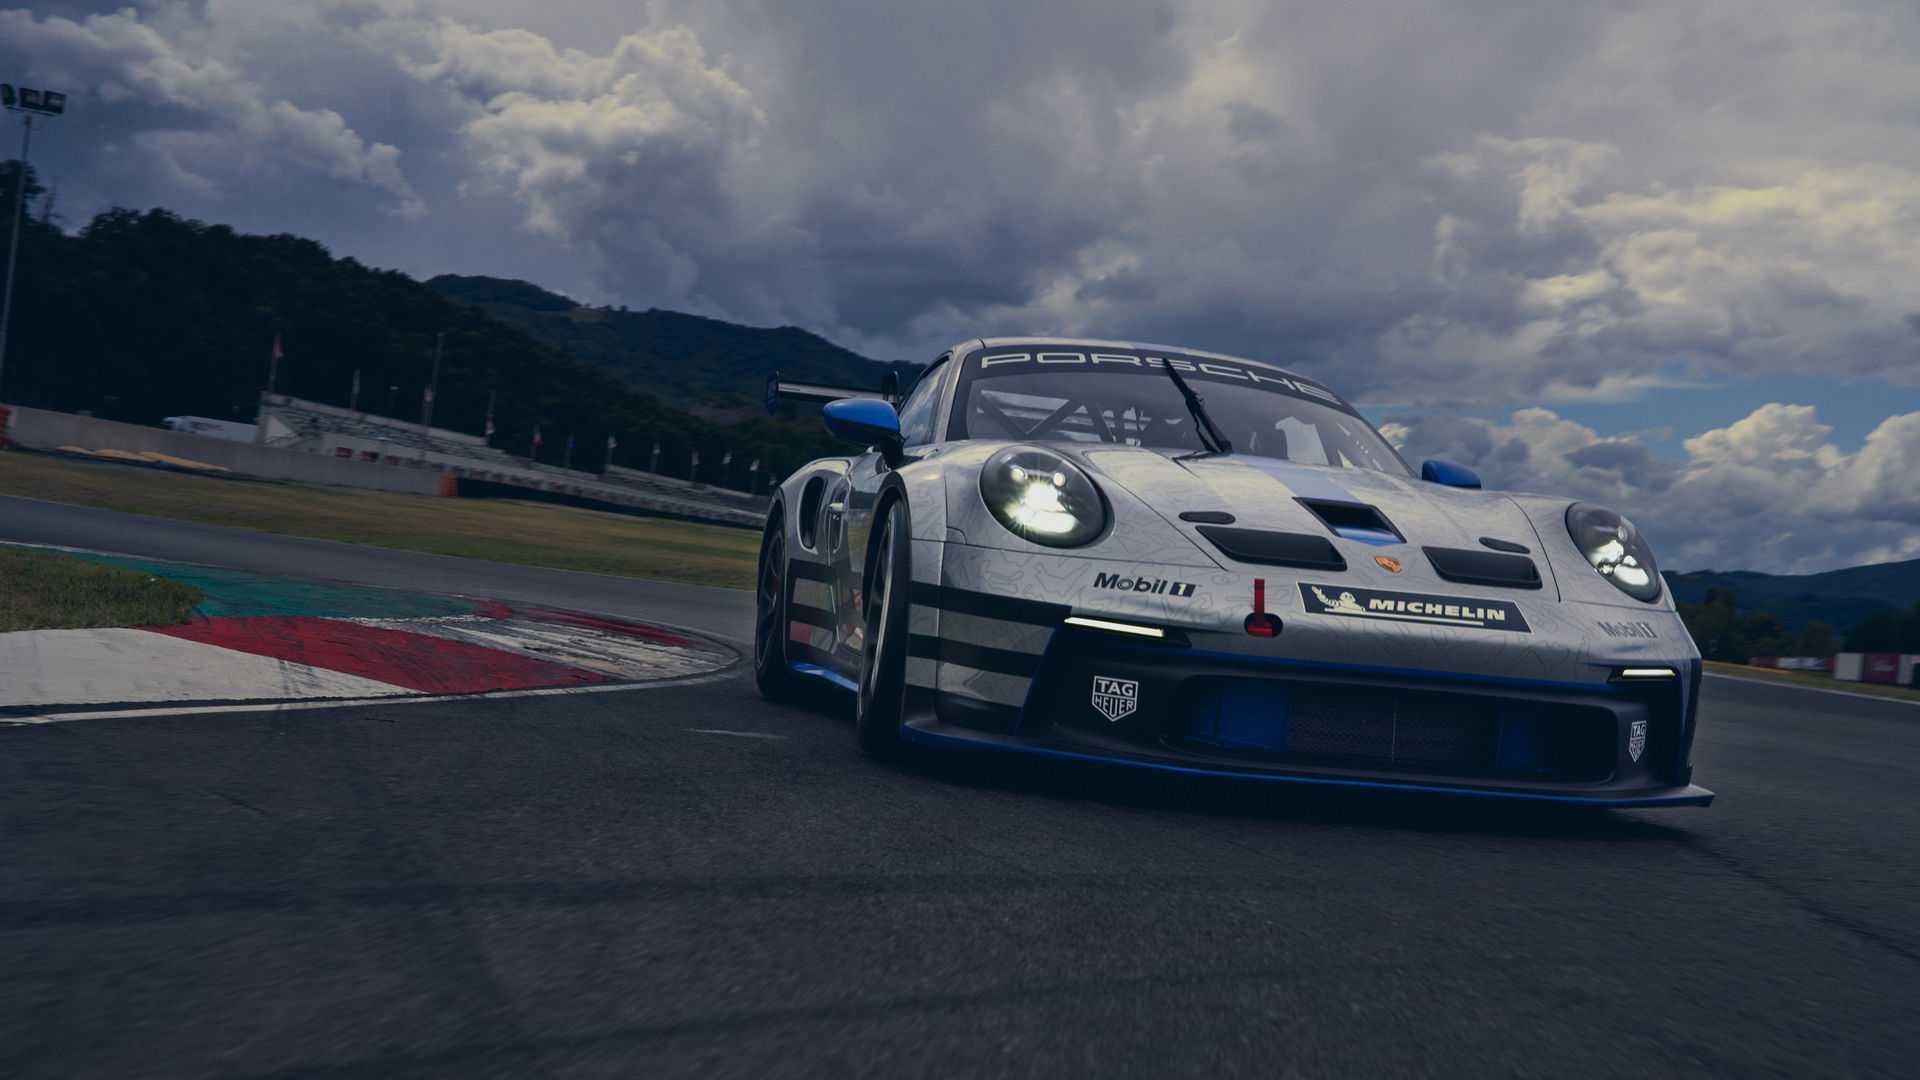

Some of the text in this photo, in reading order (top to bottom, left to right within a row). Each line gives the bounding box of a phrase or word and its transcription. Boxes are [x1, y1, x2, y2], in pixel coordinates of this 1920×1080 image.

[981, 352, 1341, 405] PORSCHE
[1094, 572, 1168, 594] Mobil
[1369, 598, 1506, 621] MICHELIN
[1597, 621, 1643, 638] Mobil
[1097, 680, 1134, 697] TAG
[1094, 695, 1134, 718] HEUER
[1633, 724, 1645, 737] TAG
